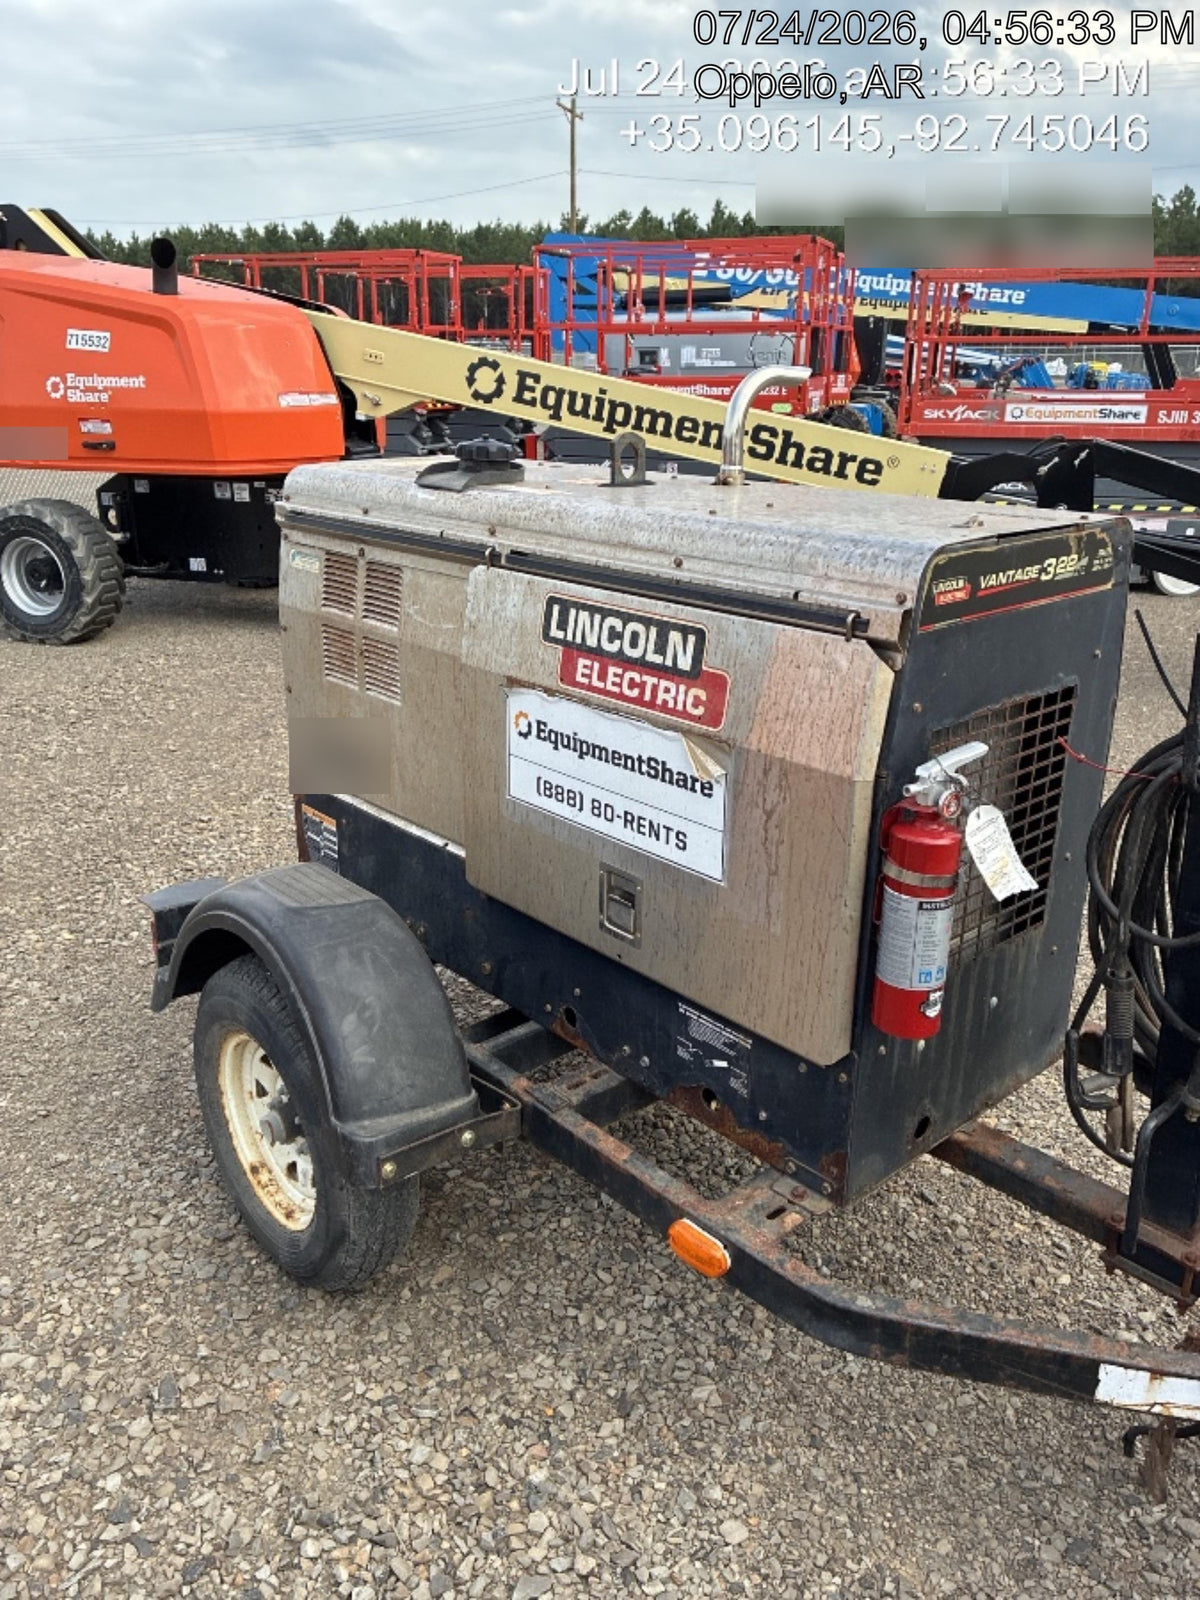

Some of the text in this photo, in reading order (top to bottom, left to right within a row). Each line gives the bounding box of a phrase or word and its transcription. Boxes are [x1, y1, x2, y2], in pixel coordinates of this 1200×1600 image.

[65, 373, 147, 390] Equipment
[66, 389, 109, 403] Share
[1025, 407, 1141, 420] EquipmentShare
[979, 565, 1042, 590] VANTAGE
[549, 604, 695, 671] LINCOLN
[575, 657, 707, 717] ELECTRIC
[535, 719, 714, 799] EquipmentShare
[536, 776, 688, 852] (888) 80-RENTS
